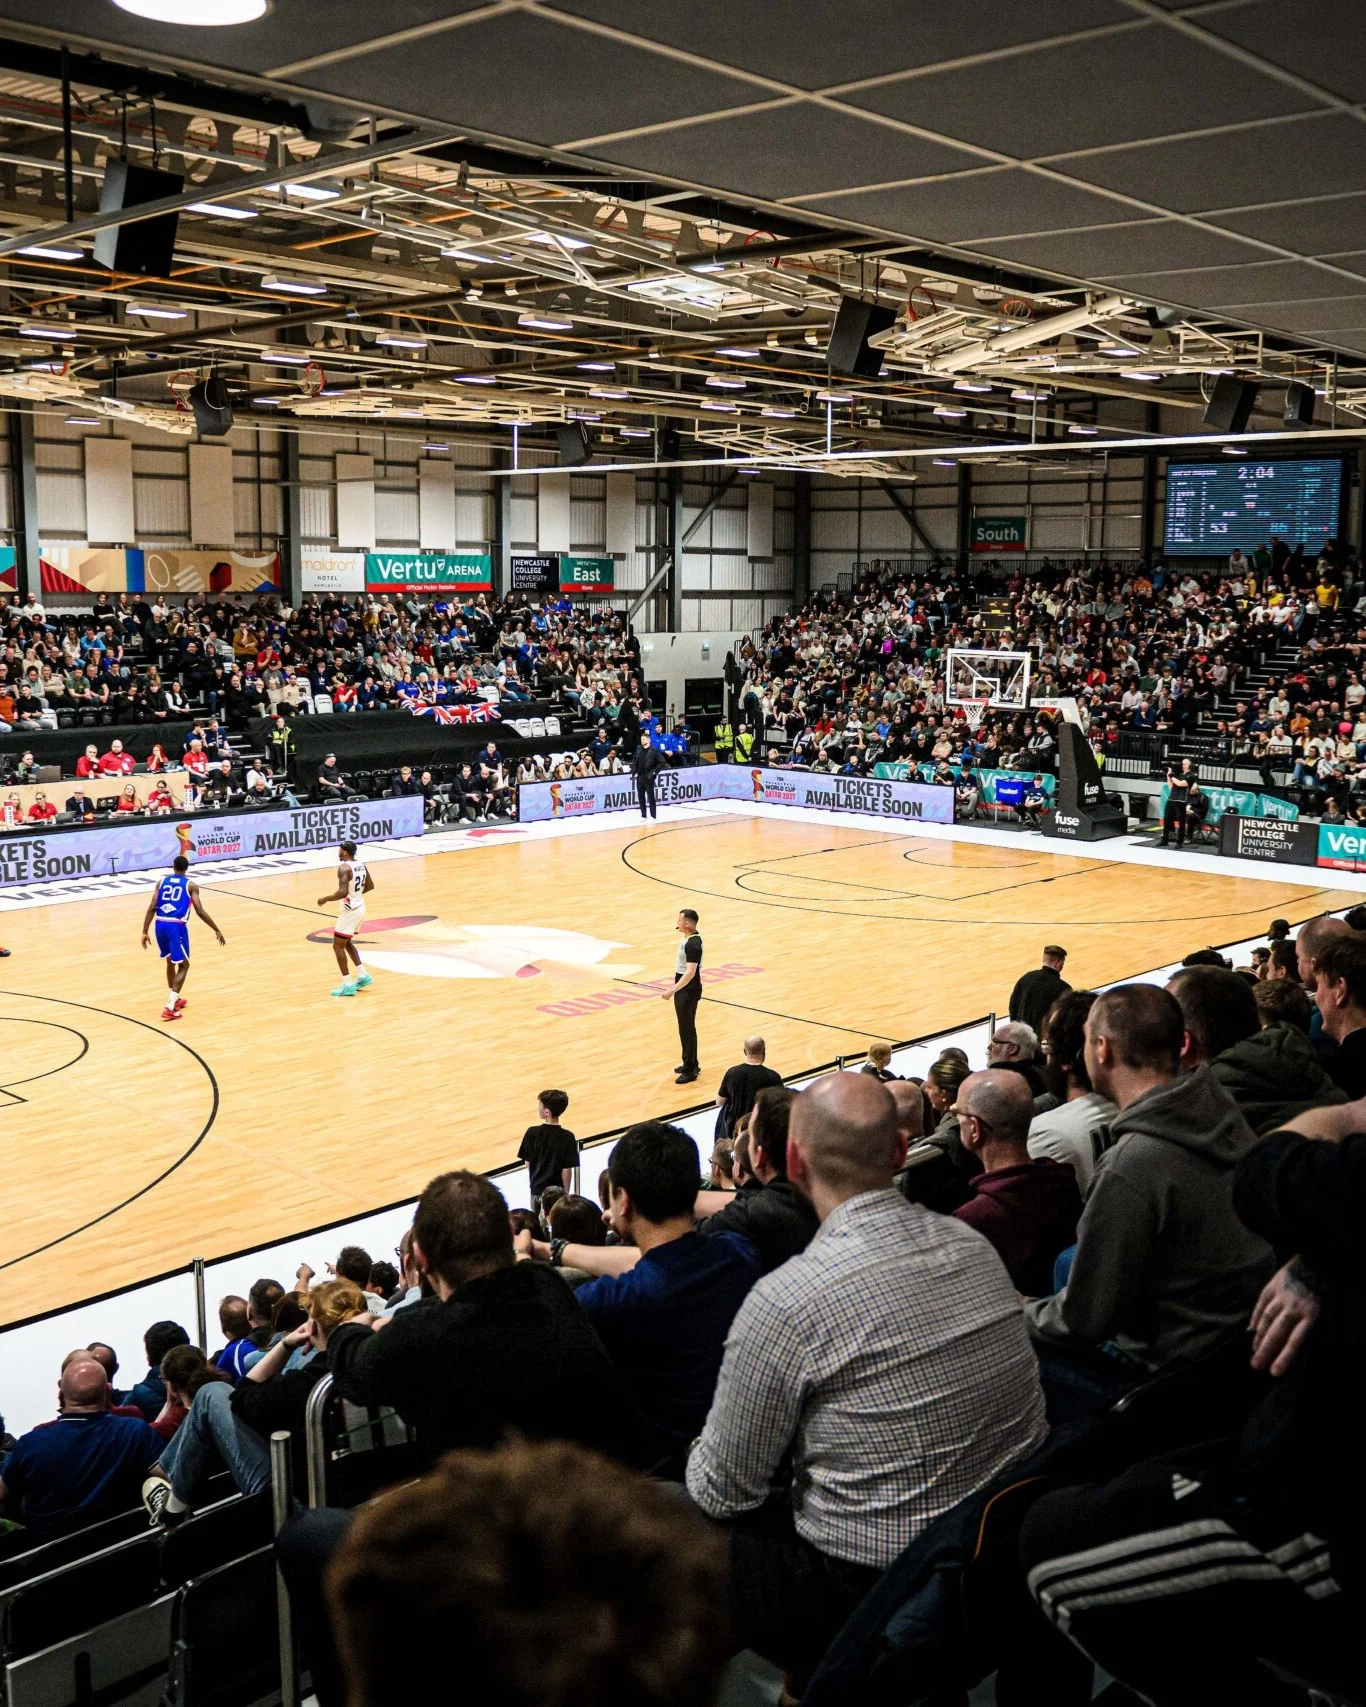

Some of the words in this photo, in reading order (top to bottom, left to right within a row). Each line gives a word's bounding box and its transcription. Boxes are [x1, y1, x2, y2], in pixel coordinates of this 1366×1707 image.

[1238, 467, 1274, 478] 2:04
[976, 527, 1019, 541] South
[376, 558, 437, 580] Vertu
[447, 565, 482, 576] ARENA
[515, 559, 550, 567] NEWCASTLE
[573, 567, 601, 581] East
[833, 778, 893, 798] TICKETS
[1084, 782, 1099, 795] fuse
[604, 788, 668, 808] AVAILLE
[671, 783, 702, 801] SOON
[805, 790, 880, 812] AVAILABLE
[882, 798, 923, 817] SOON
[291, 806, 360, 829] TICKETS
[1055, 811, 1080, 826] fuse
[1243, 819, 1300, 833] NEWCASTLE
[197, 837, 225, 846] WORLD
[226, 835, 241, 843] CUP
[254, 825, 346, 852] AVAILABLE
[349, 820, 393, 840] SOON
[1242, 828, 1286, 841] COLLEGE
[197, 845, 222, 856] QATAR
[223, 843, 241, 853] 2027
[1242, 838, 1294, 851] UNIVERSITY
[1241, 846, 1277, 858] CENTRE
[32, 854, 91, 879] SOON
[0, 876, 157, 901] VERTU
[161, 884, 183, 902] 20
